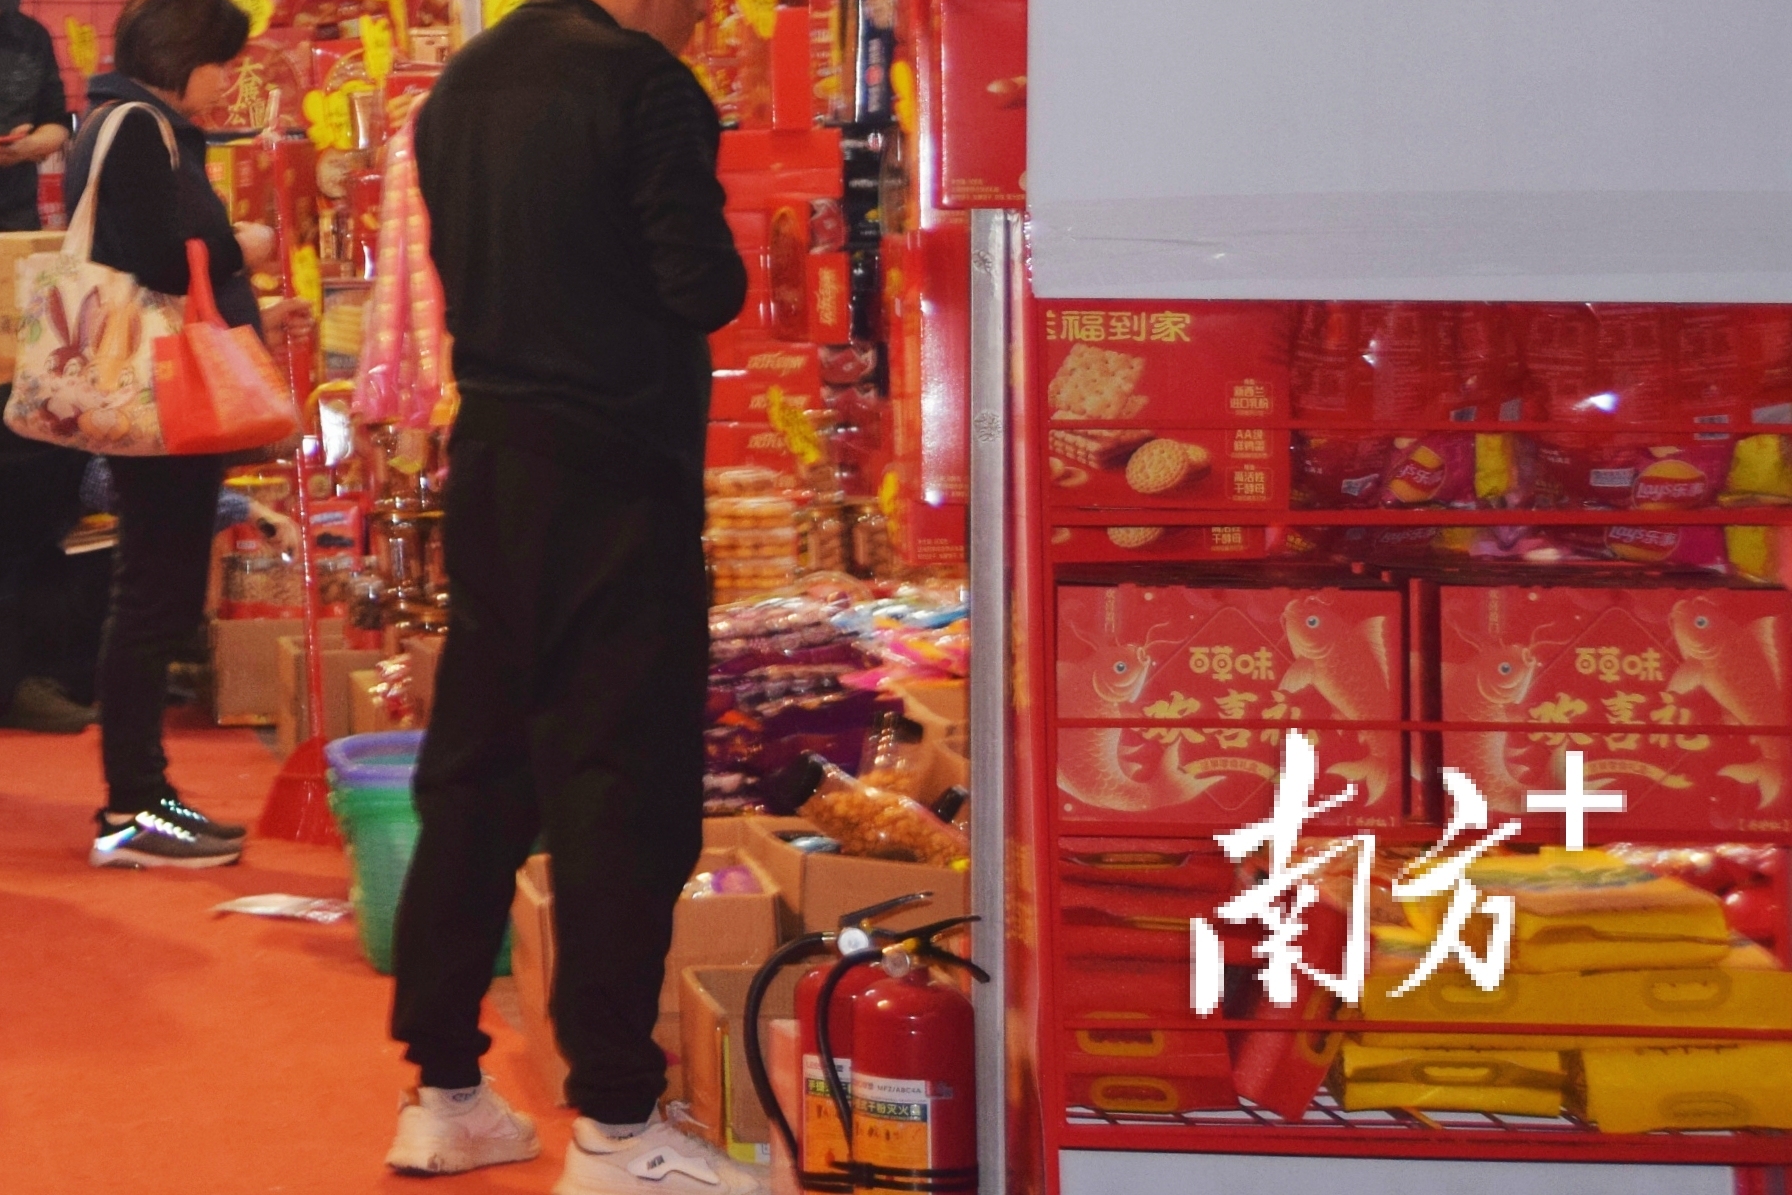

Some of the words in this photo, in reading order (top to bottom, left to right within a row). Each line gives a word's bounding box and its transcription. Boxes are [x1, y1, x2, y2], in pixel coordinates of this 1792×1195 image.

[1189, 644, 1275, 682] 百草味
[1574, 646, 1665, 683] 百草味
[1527, 690, 1712, 752] 欢喜礼
